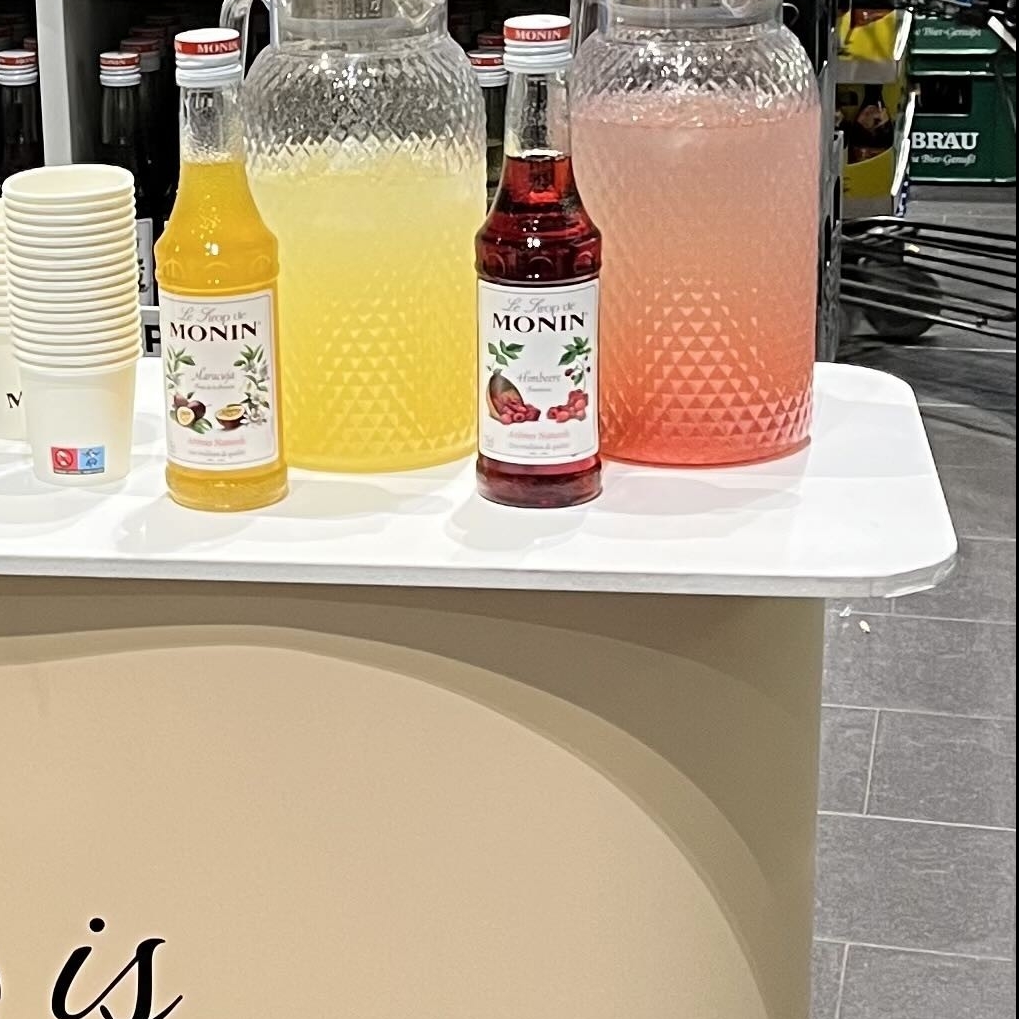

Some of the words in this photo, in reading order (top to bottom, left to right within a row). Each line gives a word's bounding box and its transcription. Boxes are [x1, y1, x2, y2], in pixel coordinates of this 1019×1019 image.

[514, 29, 561, 41] MONIN
[170, 320, 257, 342] MONIN
[493, 311, 586, 333] MONIN
[52, 917, 183, 1019] is
